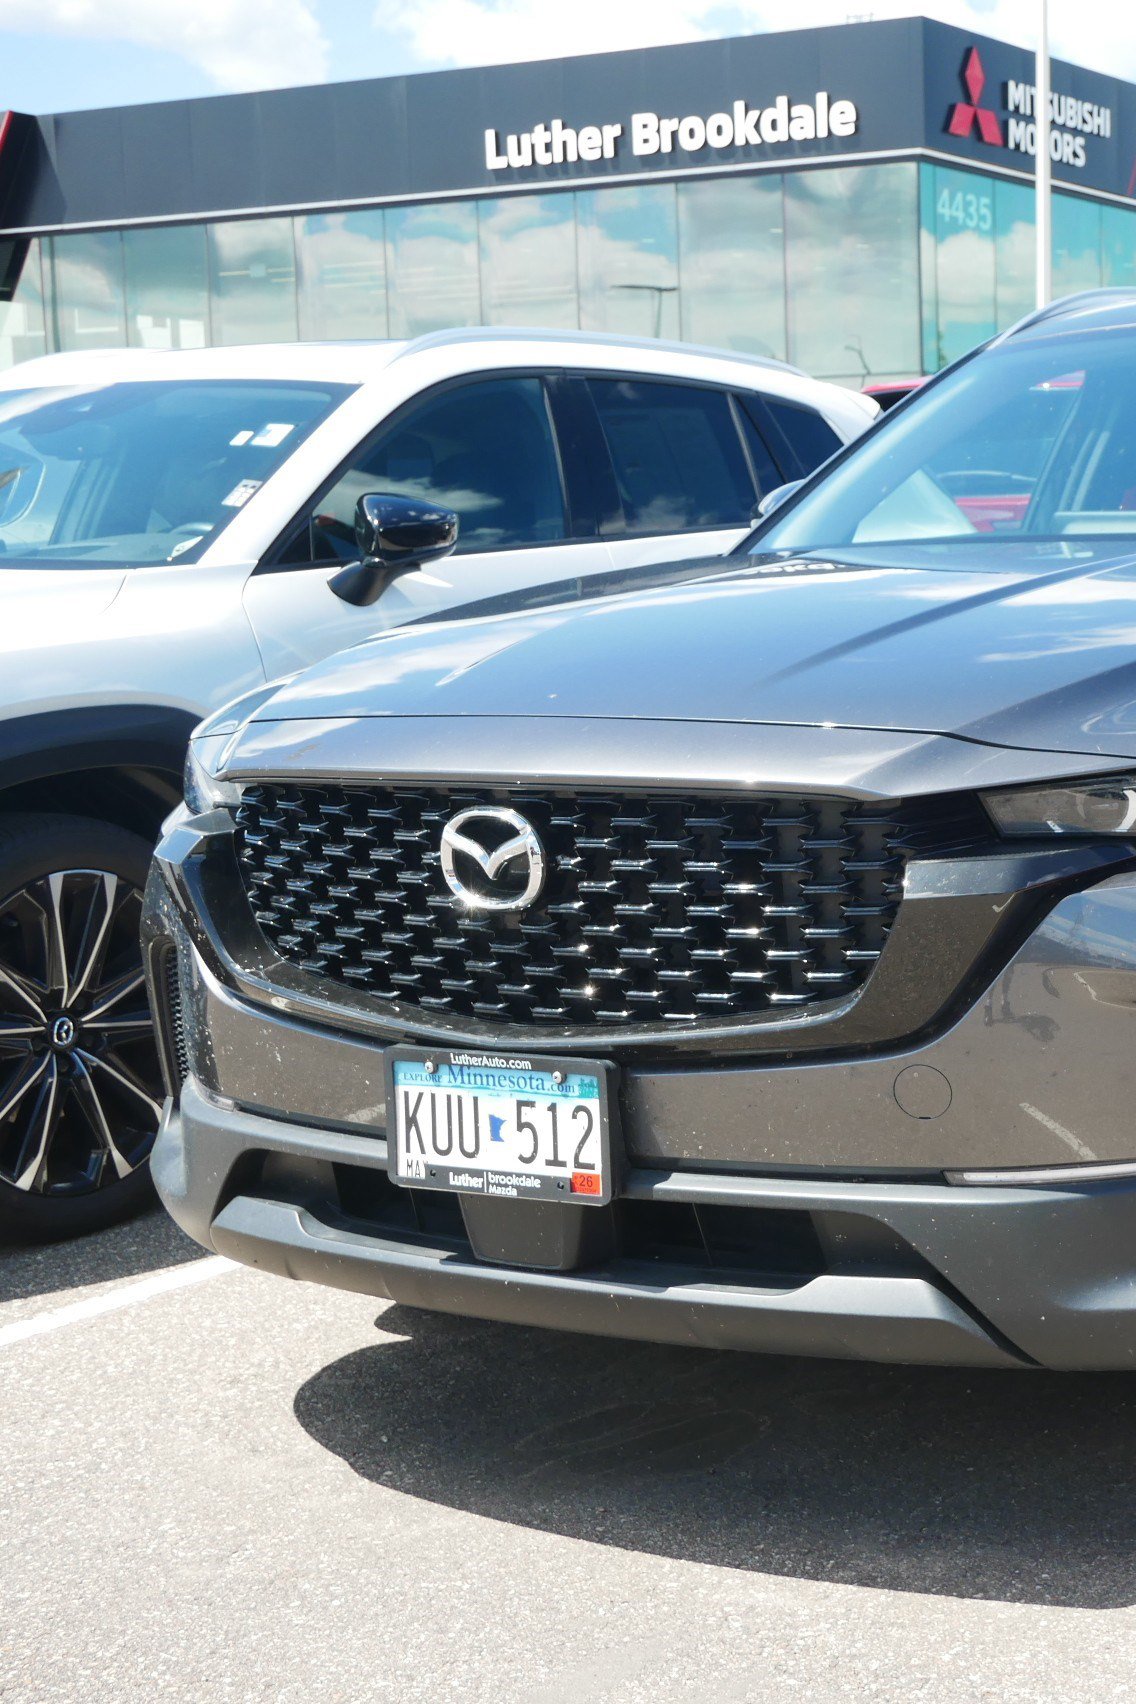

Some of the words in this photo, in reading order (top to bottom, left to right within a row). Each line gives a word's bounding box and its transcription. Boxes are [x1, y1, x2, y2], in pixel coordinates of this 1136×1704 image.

[484, 117, 622, 170] Luther
[631, 91, 857, 156] Brookdale
[1008, 118, 1086, 168] MOORS
[937, 189, 992, 230] 4435
[450, 1053, 532, 1070] LutherAuto.com
[404, 1091, 480, 1158] KUU
[516, 1100, 596, 1171] 512
[406, 1159, 428, 1178] MA
[449, 1172, 484, 1188] Luther
[488, 1172, 541, 1188] brookdale
[488, 1184, 518, 1196] Mazda
